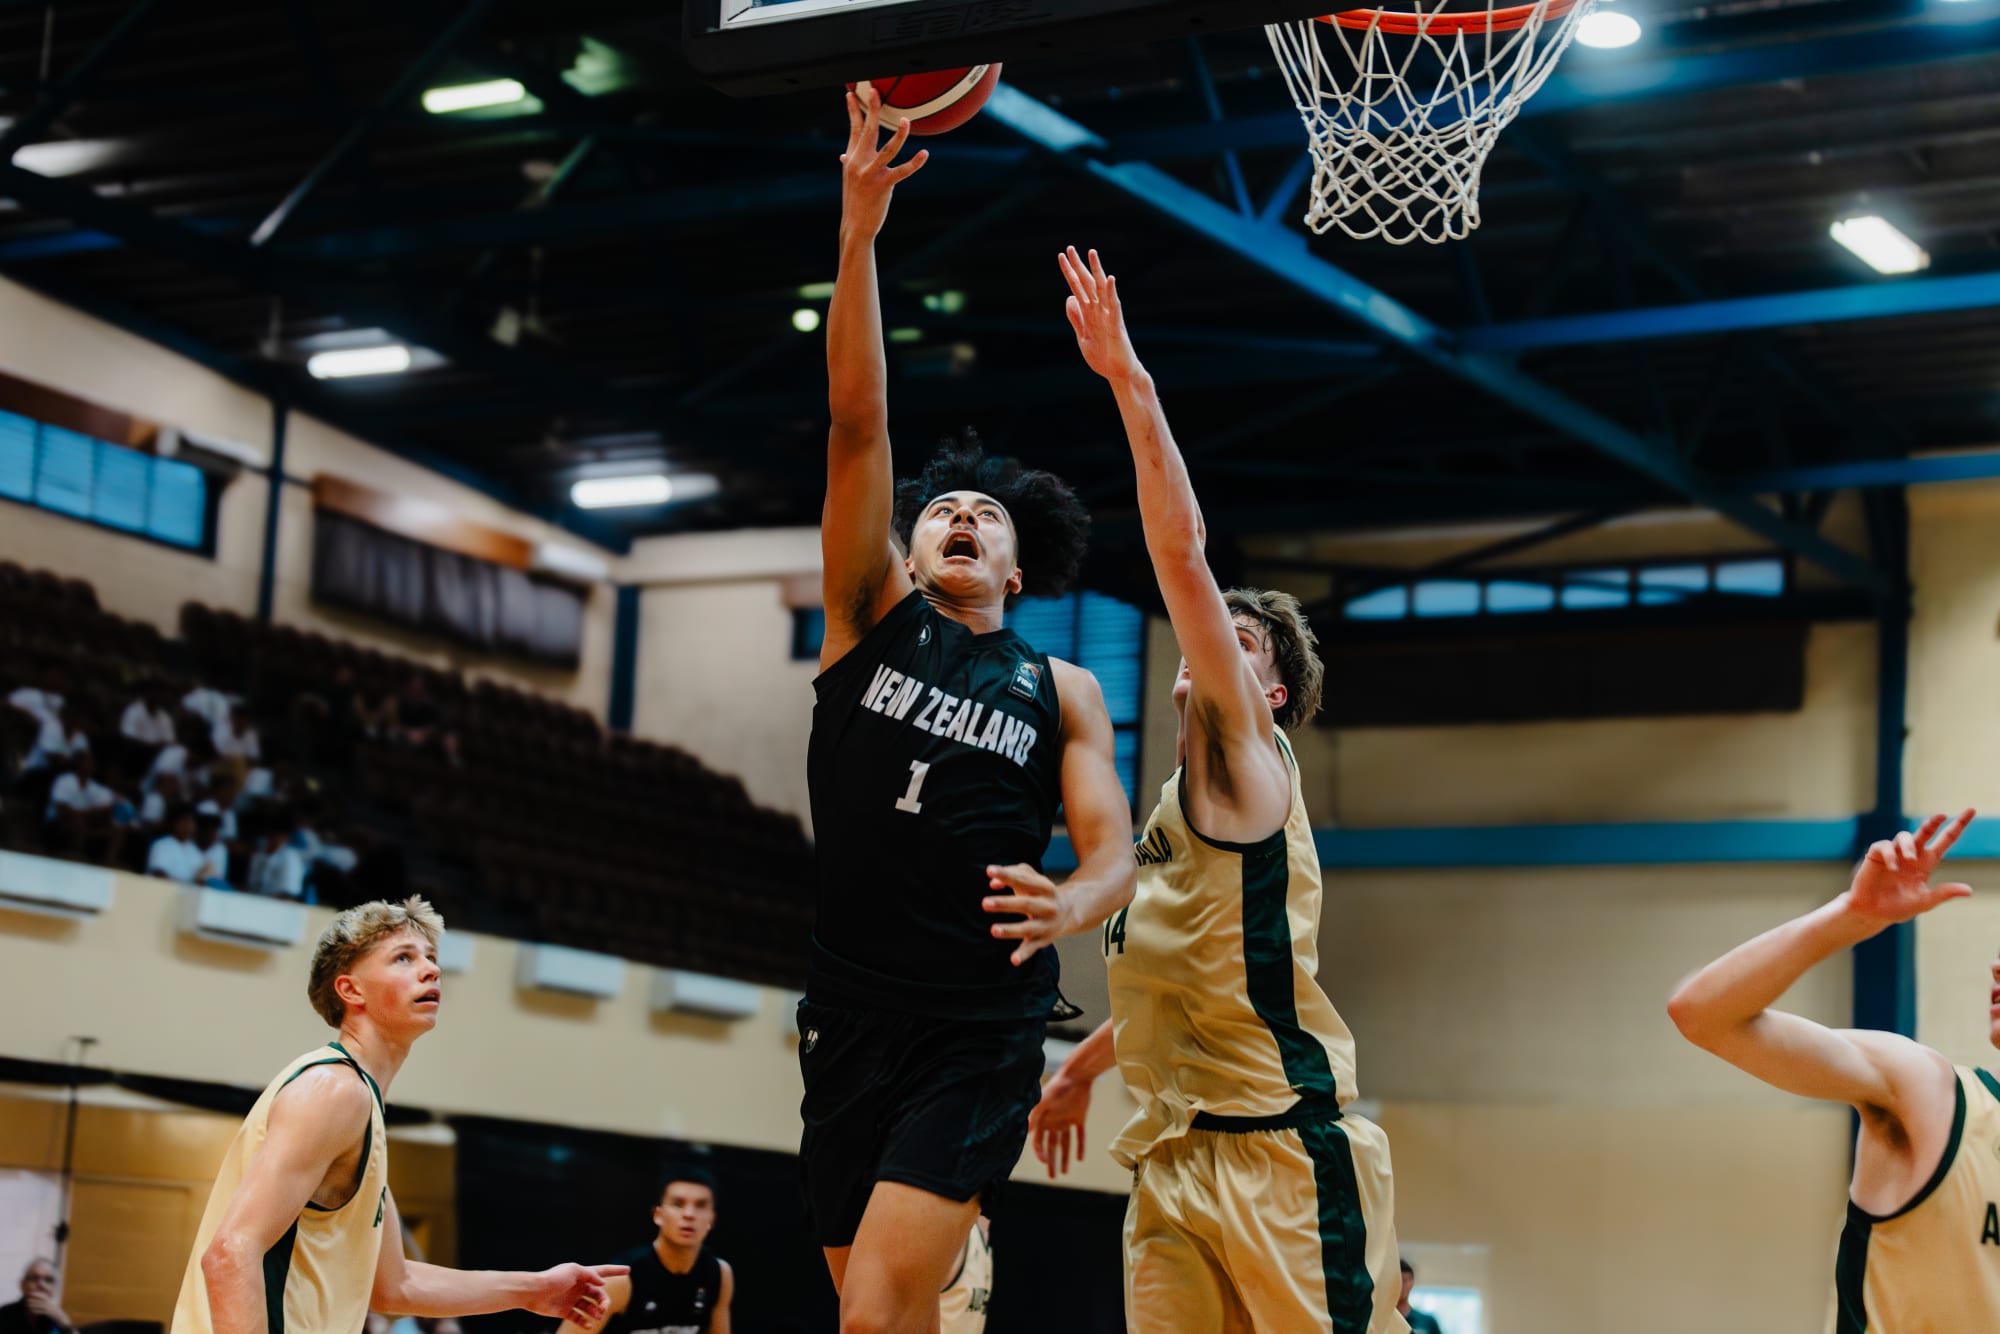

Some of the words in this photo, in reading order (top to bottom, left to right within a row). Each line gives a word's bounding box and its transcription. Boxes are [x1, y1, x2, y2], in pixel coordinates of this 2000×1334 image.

[861, 664, 924, 721] NEW
[913, 686, 1038, 767] ZEALAND
[895, 759, 930, 814] 1
